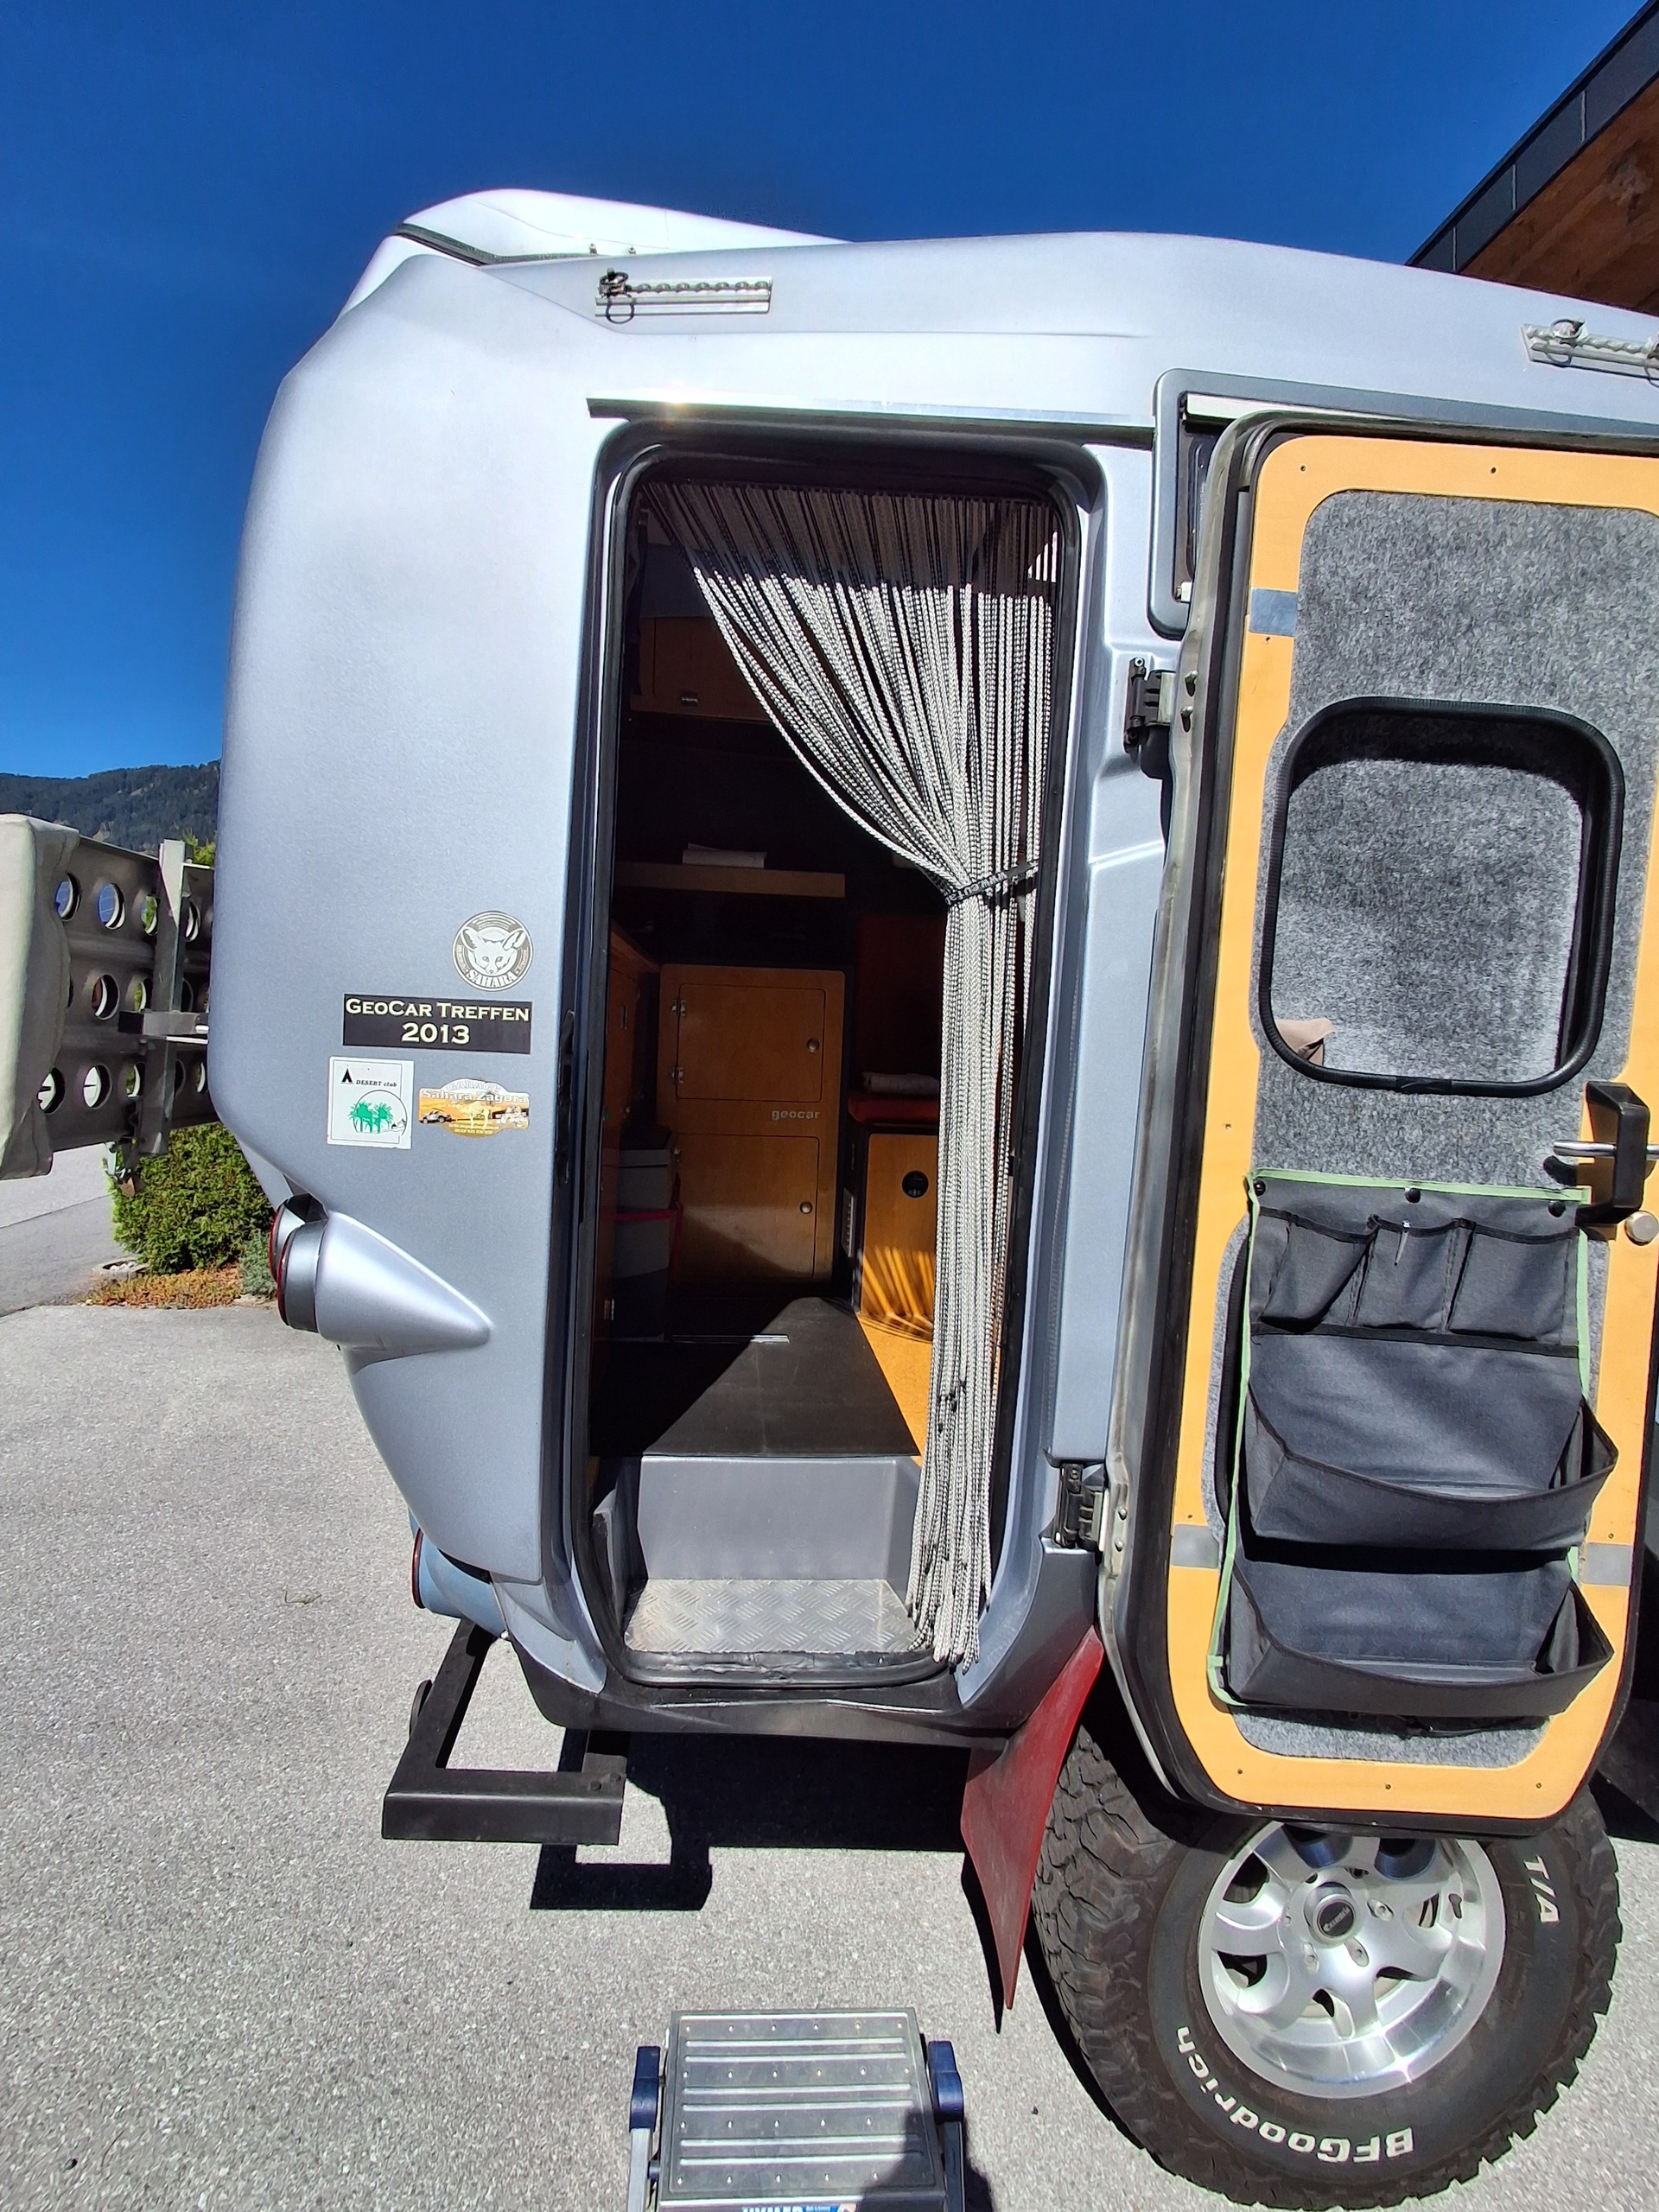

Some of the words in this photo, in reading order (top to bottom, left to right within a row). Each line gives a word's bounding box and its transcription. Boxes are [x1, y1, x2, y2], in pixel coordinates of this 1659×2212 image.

[467, 969, 518, 988] SAHARA
[402, 1022, 470, 1045] 2013
[423, 1089, 473, 1100] Sahara
[476, 1090, 526, 1103] Zagora
[772, 1110, 820, 1121] geocar
[1523, 1855, 1560, 1923] T/A
[1177, 2026, 1414, 2163] BFGoodrich
